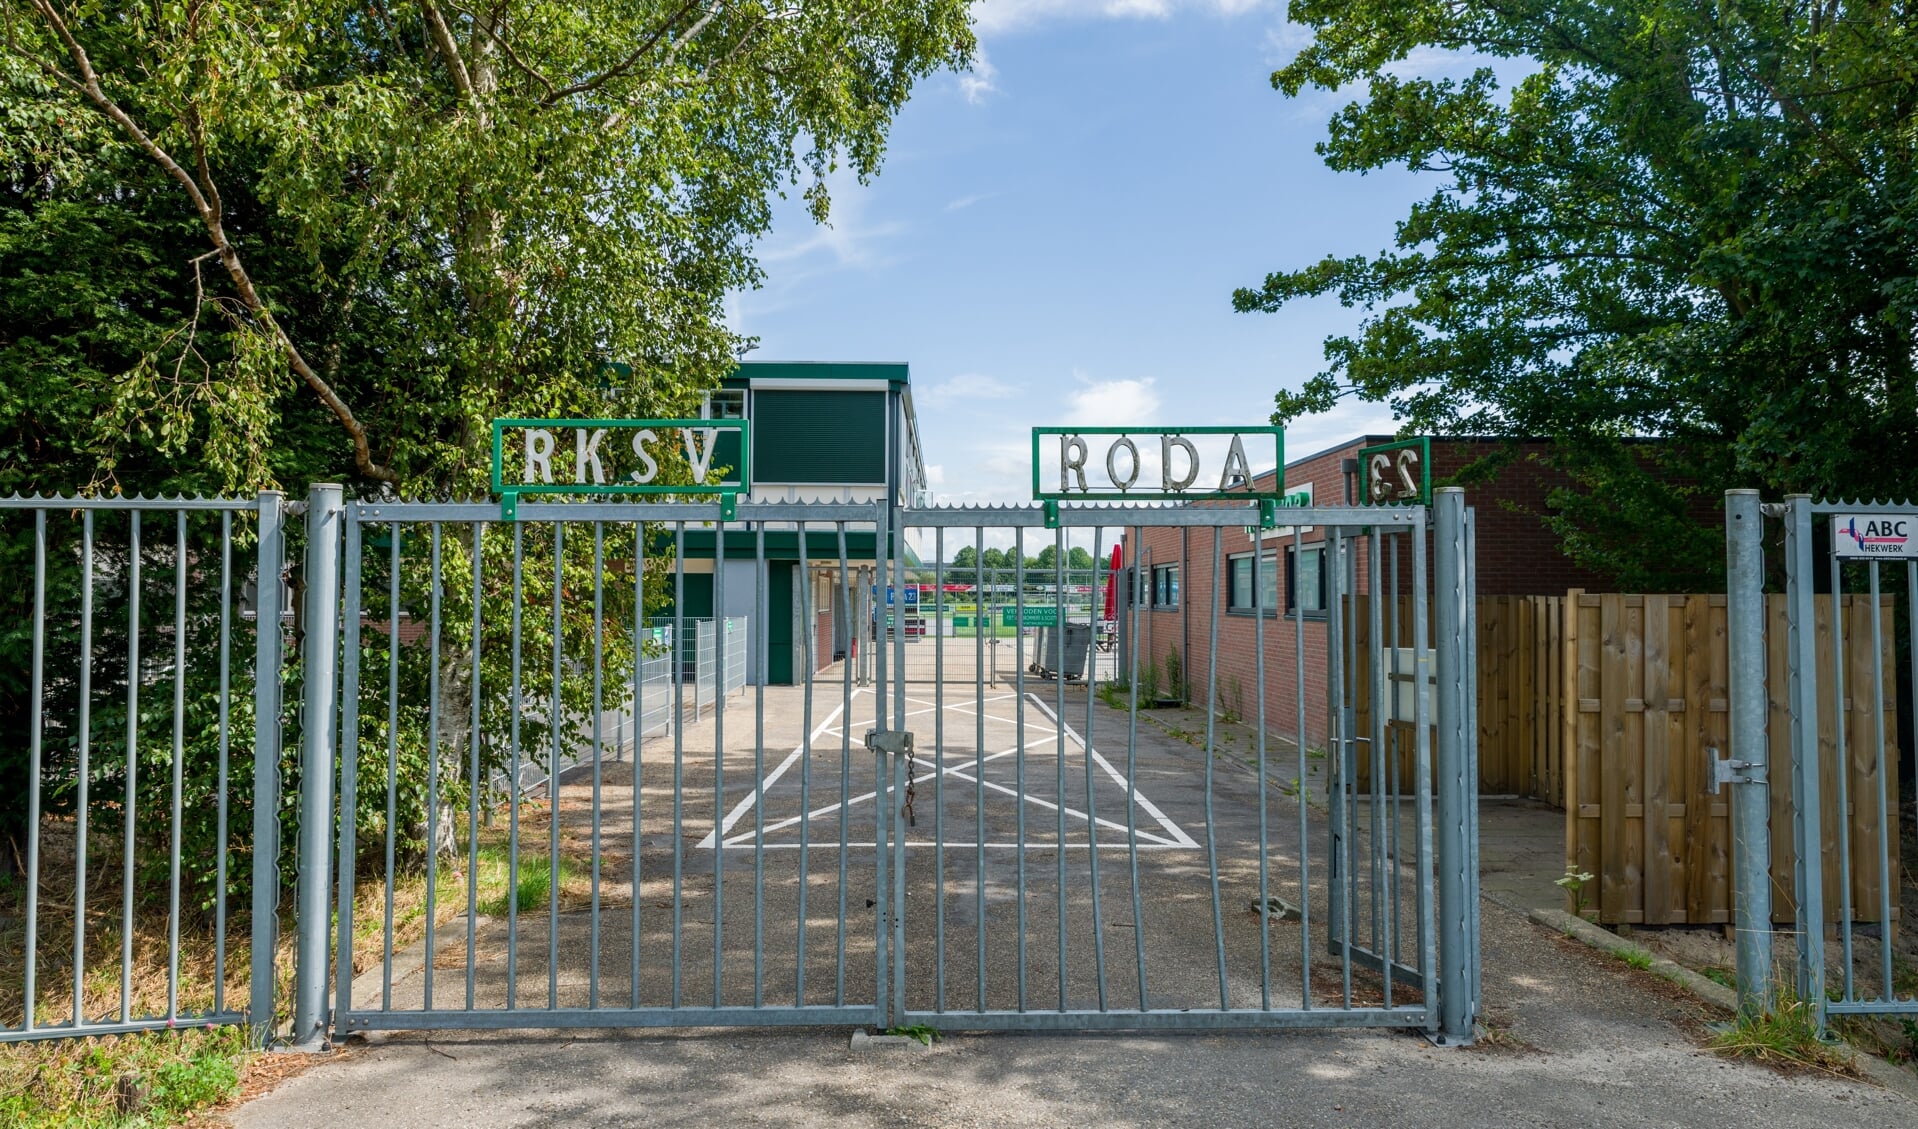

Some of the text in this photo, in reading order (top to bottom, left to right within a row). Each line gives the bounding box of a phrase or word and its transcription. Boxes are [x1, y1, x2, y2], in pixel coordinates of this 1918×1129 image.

[523, 427, 718, 484] RKSV
[1060, 435, 1256, 491] RODA
[1865, 520, 1908, 537] ABC
[1864, 544, 1903, 553] HEKWERK
